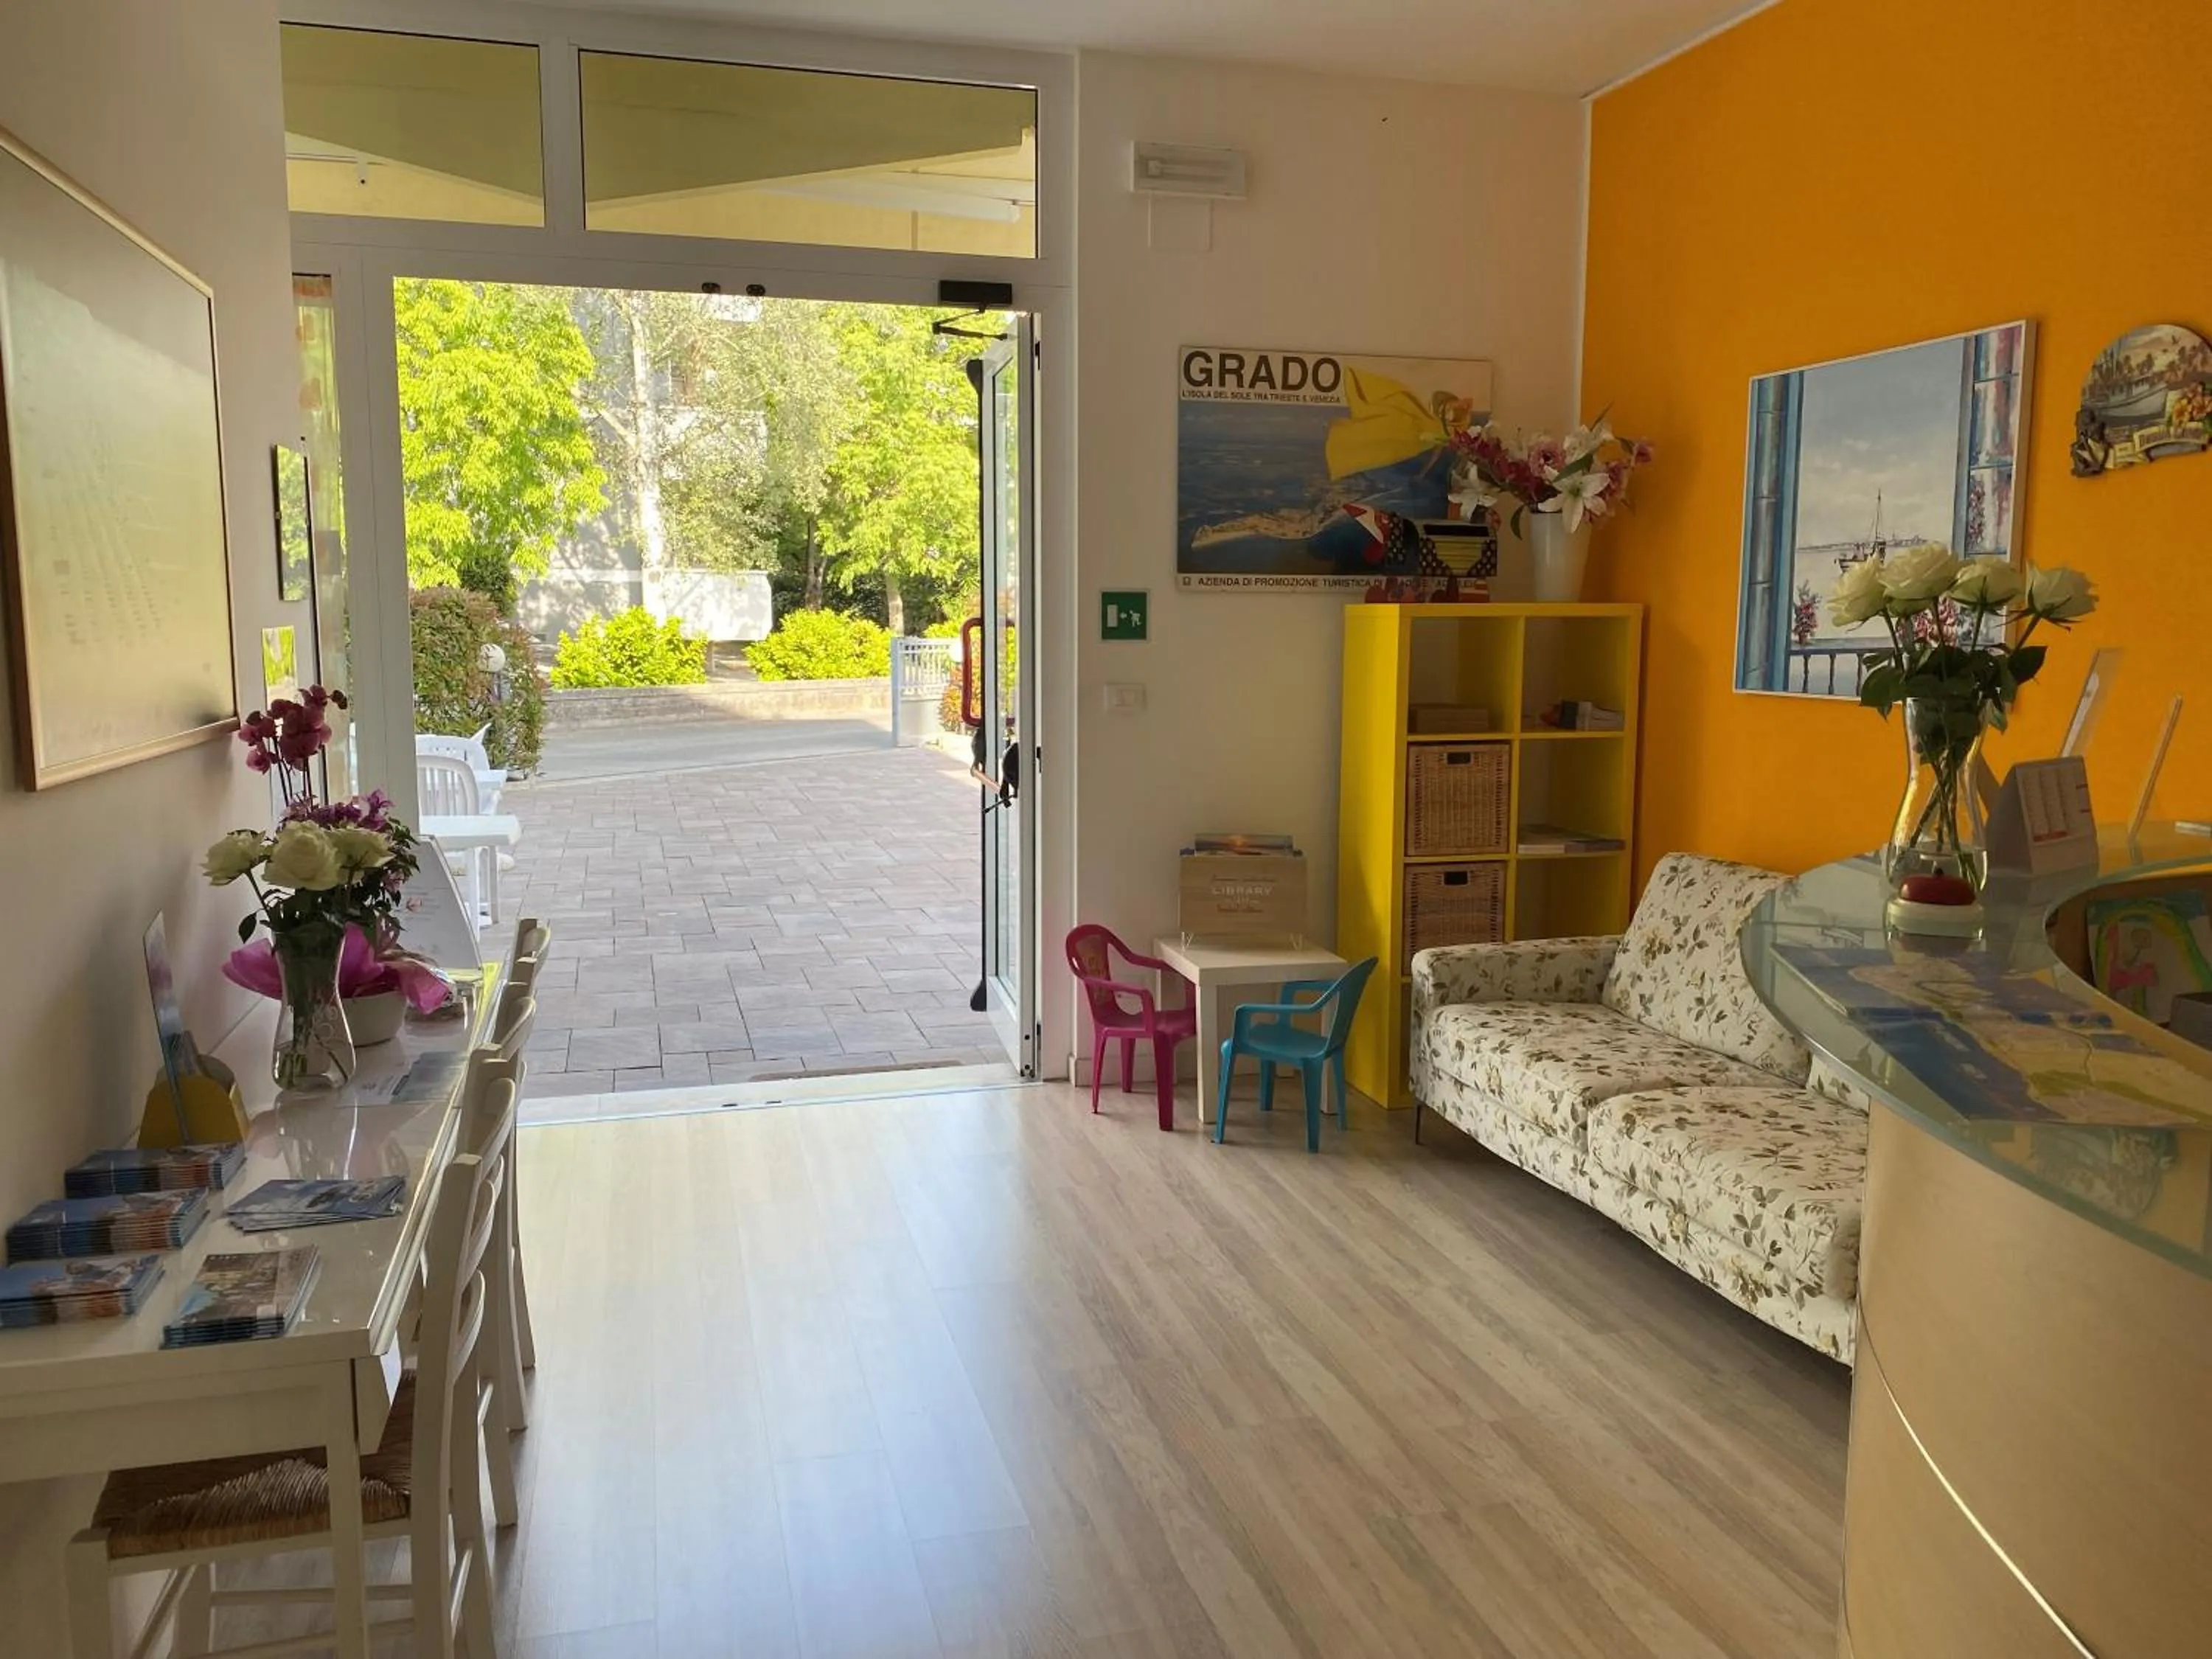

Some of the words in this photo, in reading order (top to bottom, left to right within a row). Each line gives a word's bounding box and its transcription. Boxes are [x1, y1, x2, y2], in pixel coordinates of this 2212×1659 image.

[1183, 350, 1340, 393] GRADO
[1182, 390, 1211, 399] L'ISOLA
[1214, 392, 1229, 400] DEL
[1231, 392, 1252, 400] SOLE
[1254, 392, 1269, 401] TRA
[1270, 393, 1300, 402] TRIESTE
[1302, 394, 1307, 402] E
[1310, 394, 1341, 403] VENEZIA
[1198, 577, 1240, 586] AZIENDA
[1242, 577, 1251, 586] DI
[1254, 577, 1318, 588] PROMOZIONE
[1323, 578, 1371, 588] TURISTICA
[1211, 886, 1274, 896] LIBRARY
